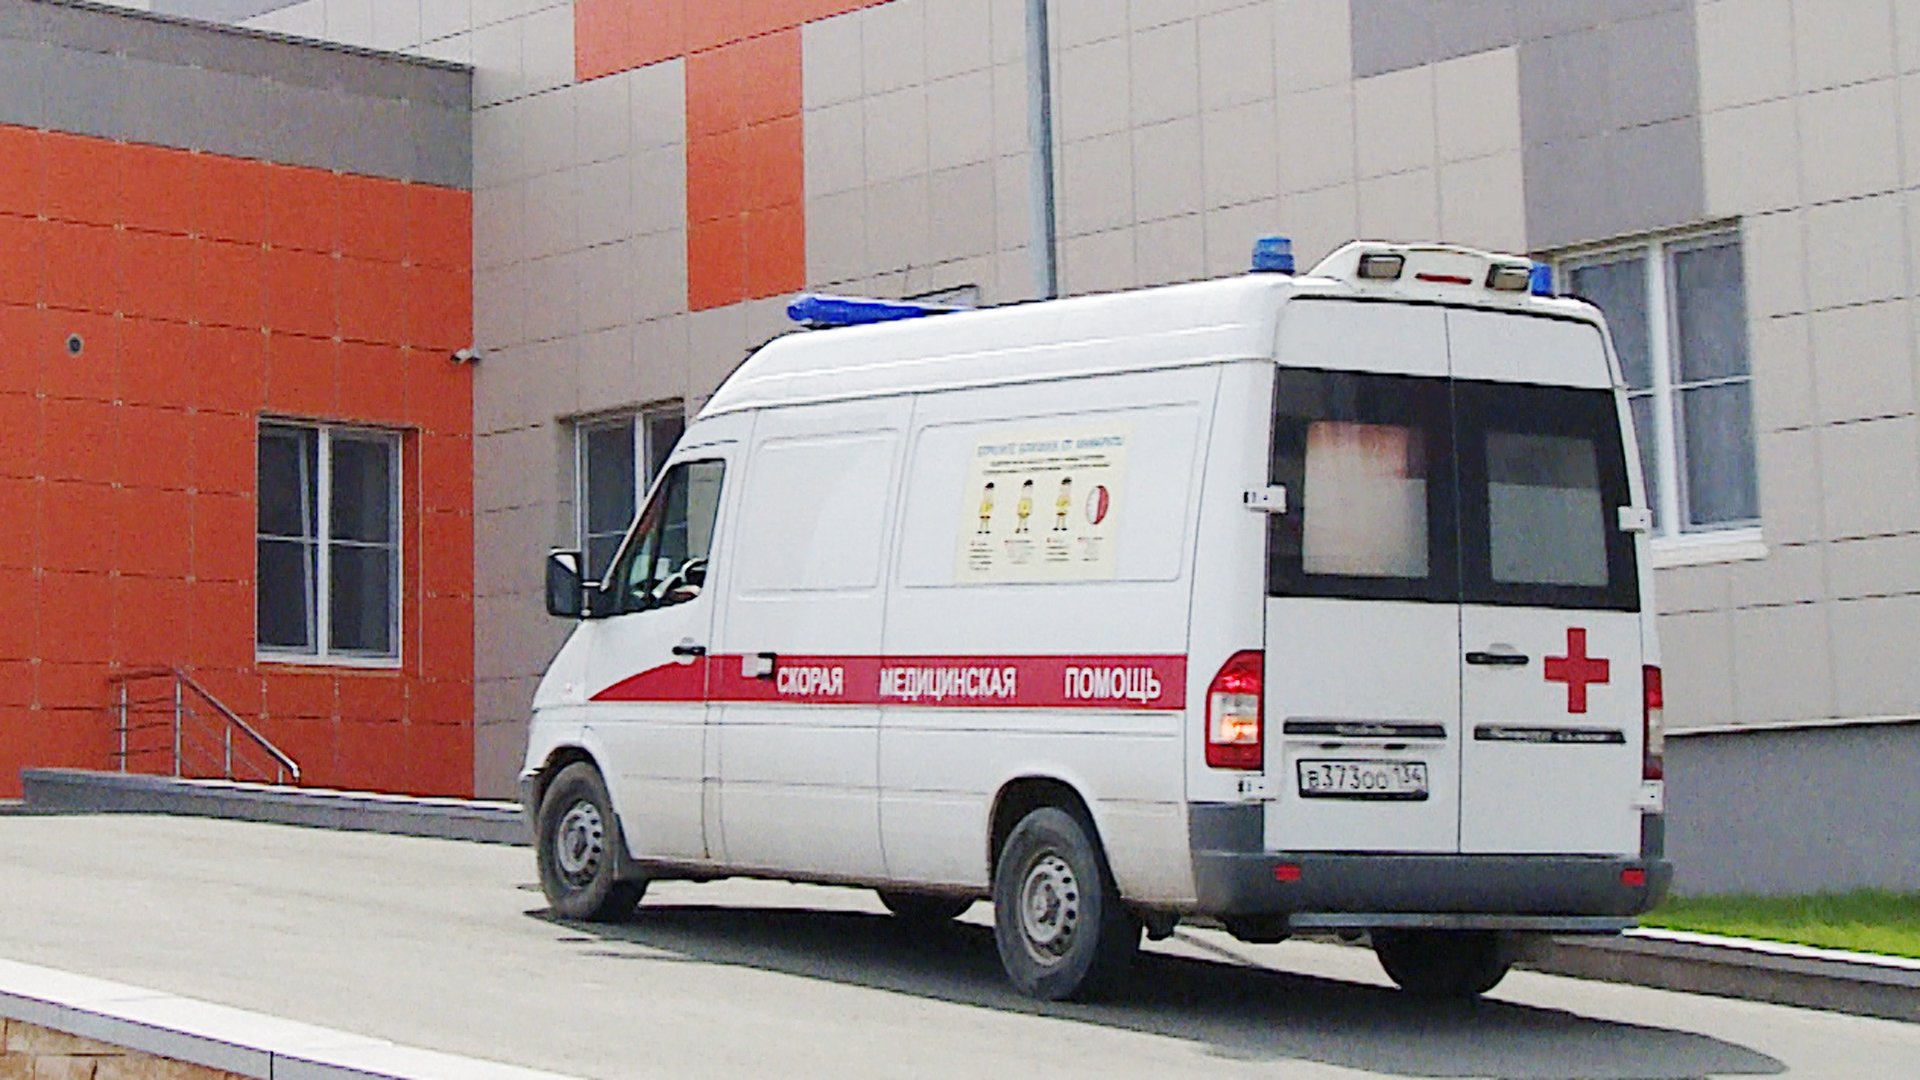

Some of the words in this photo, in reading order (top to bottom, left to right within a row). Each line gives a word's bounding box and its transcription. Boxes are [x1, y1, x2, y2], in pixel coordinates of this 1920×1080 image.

[776, 666, 844, 695] СКОРАЯ
[879, 666, 1017, 701] МЕДИЦИНСКАЯ
[1064, 666, 1162, 703] ПОМОЩЬ
